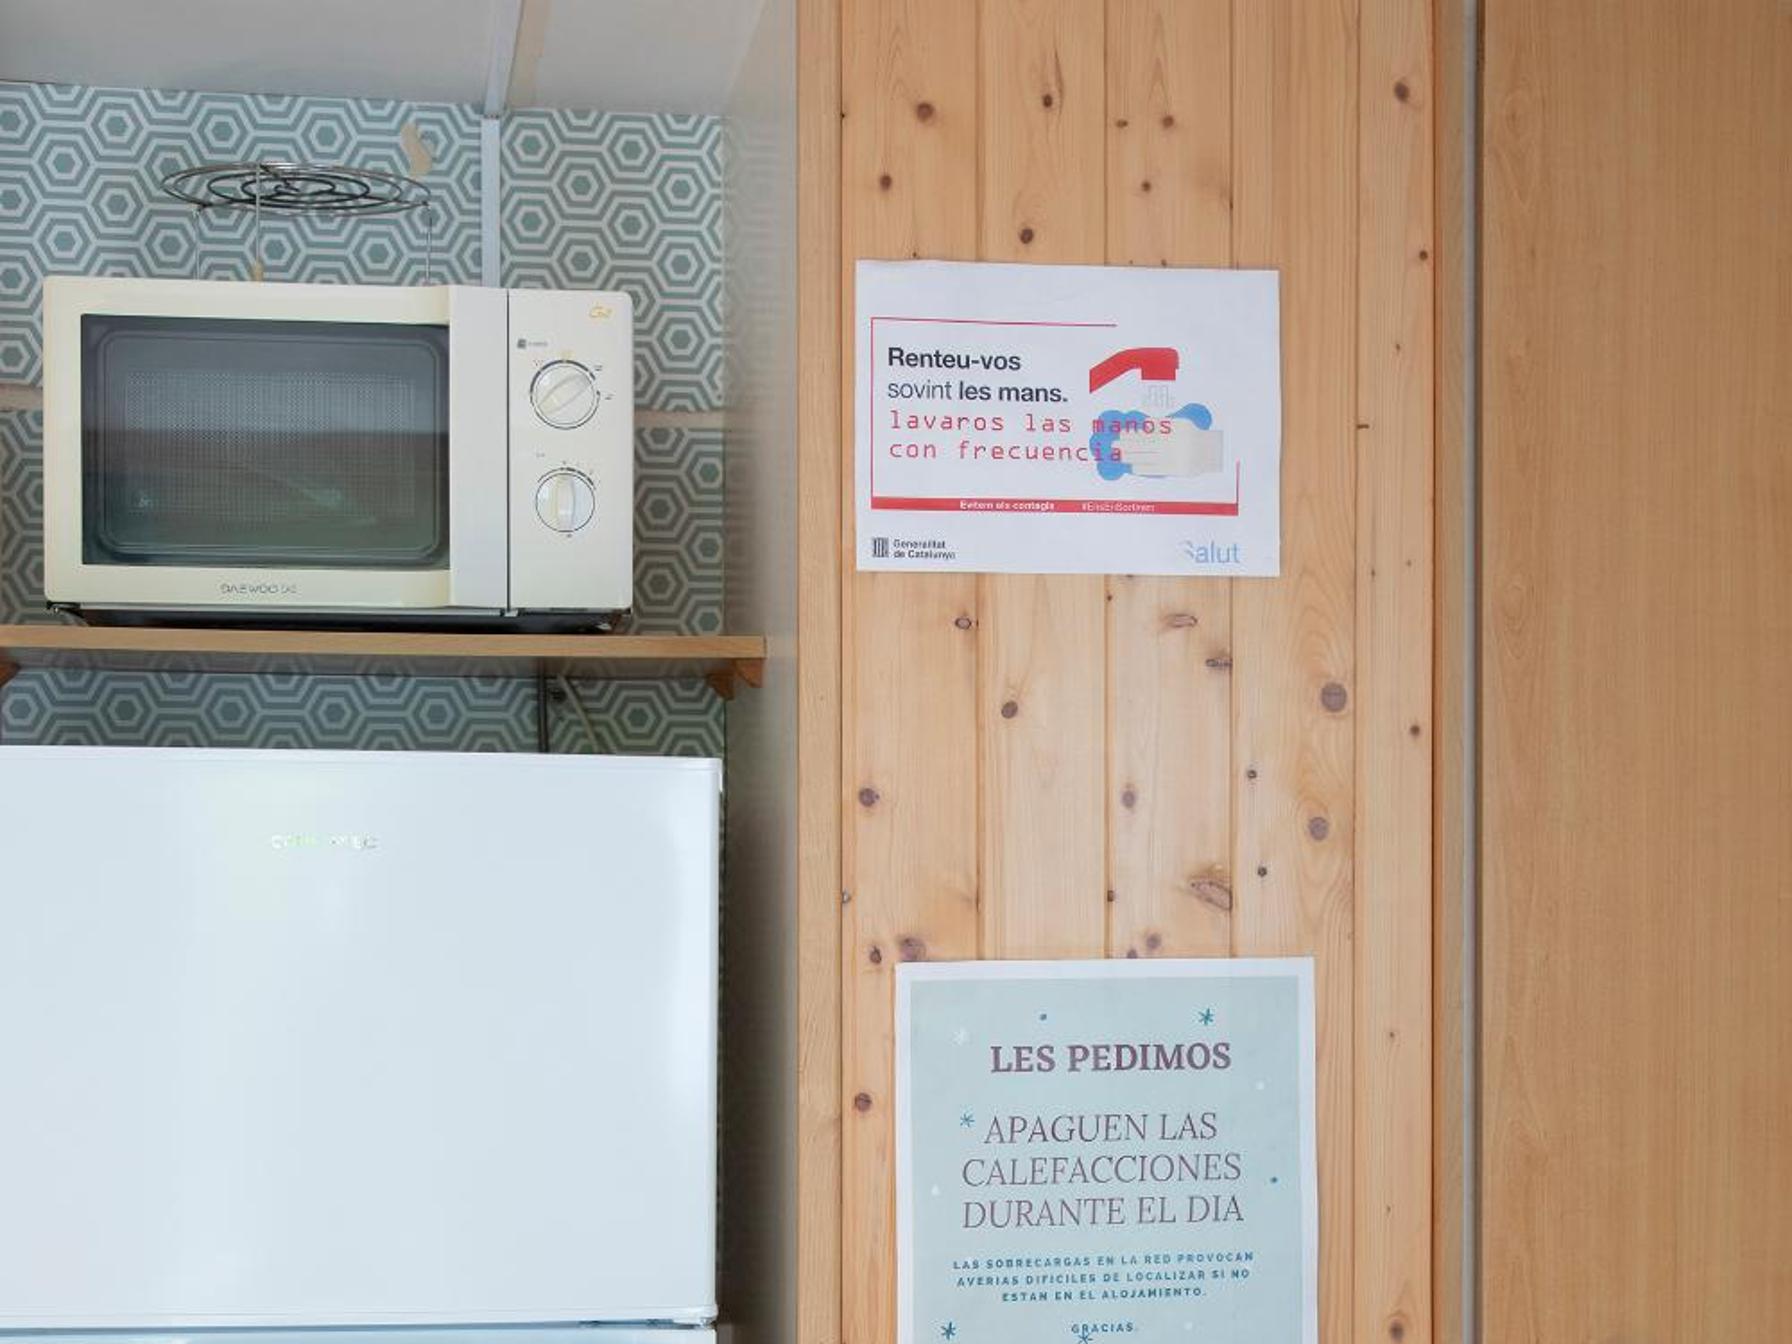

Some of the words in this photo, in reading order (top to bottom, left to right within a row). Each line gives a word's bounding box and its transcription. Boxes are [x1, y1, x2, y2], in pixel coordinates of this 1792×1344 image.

[888, 347, 1021, 371] Renteu-vos
[888, 379, 952, 400] sovint
[959, 381, 992, 401] les
[999, 386, 1068, 403] mans.
[890, 410, 1004, 431] lavaros
[1025, 413, 1071, 433] las
[1092, 416, 1172, 434] manos
[889, 443, 936, 458] con
[959, 440, 1122, 461] frecuencia
[893, 538, 945, 549] Generalitat
[894, 550, 906, 558] de
[907, 549, 957, 560] Catalunya
[990, 1046, 1056, 1073] LES
[1067, 1042, 1232, 1071] PEDIMOS
[984, 1113, 1148, 1144] APAGUEN
[1159, 1111, 1218, 1141] LAS
[962, 1153, 1242, 1187] CALEFACCIONES
[962, 1197, 1125, 1229] DURANTE
[1136, 1196, 1176, 1224] EL
[1186, 1194, 1244, 1224] DIA
[953, 1259, 979, 1269] LAS
[986, 1257, 1090, 1269] SOBRECARGAS
[1097, 1255, 1114, 1266] EN
[1121, 1255, 1137, 1265] LA
[1144, 1253, 1171, 1264] RED
[1177, 1251, 1254, 1263] PROVOCAN
[957, 1275, 1019, 1287] AVERIAS
[1026, 1273, 1096, 1285] DIFICILES
[1103, 1272, 1120, 1282] DE
[1126, 1269, 1205, 1282] LOCALIZAR
[1211, 1268, 1225, 1279] SI
[1231, 1267, 1250, 1279] NO
[1002, 1292, 1048, 1302] ESTAN
[1055, 1291, 1073, 1300] EN
[1080, 1290, 1095, 1300] EL
[1101, 1286, 1206, 1299] ALOJAMIENTO.
